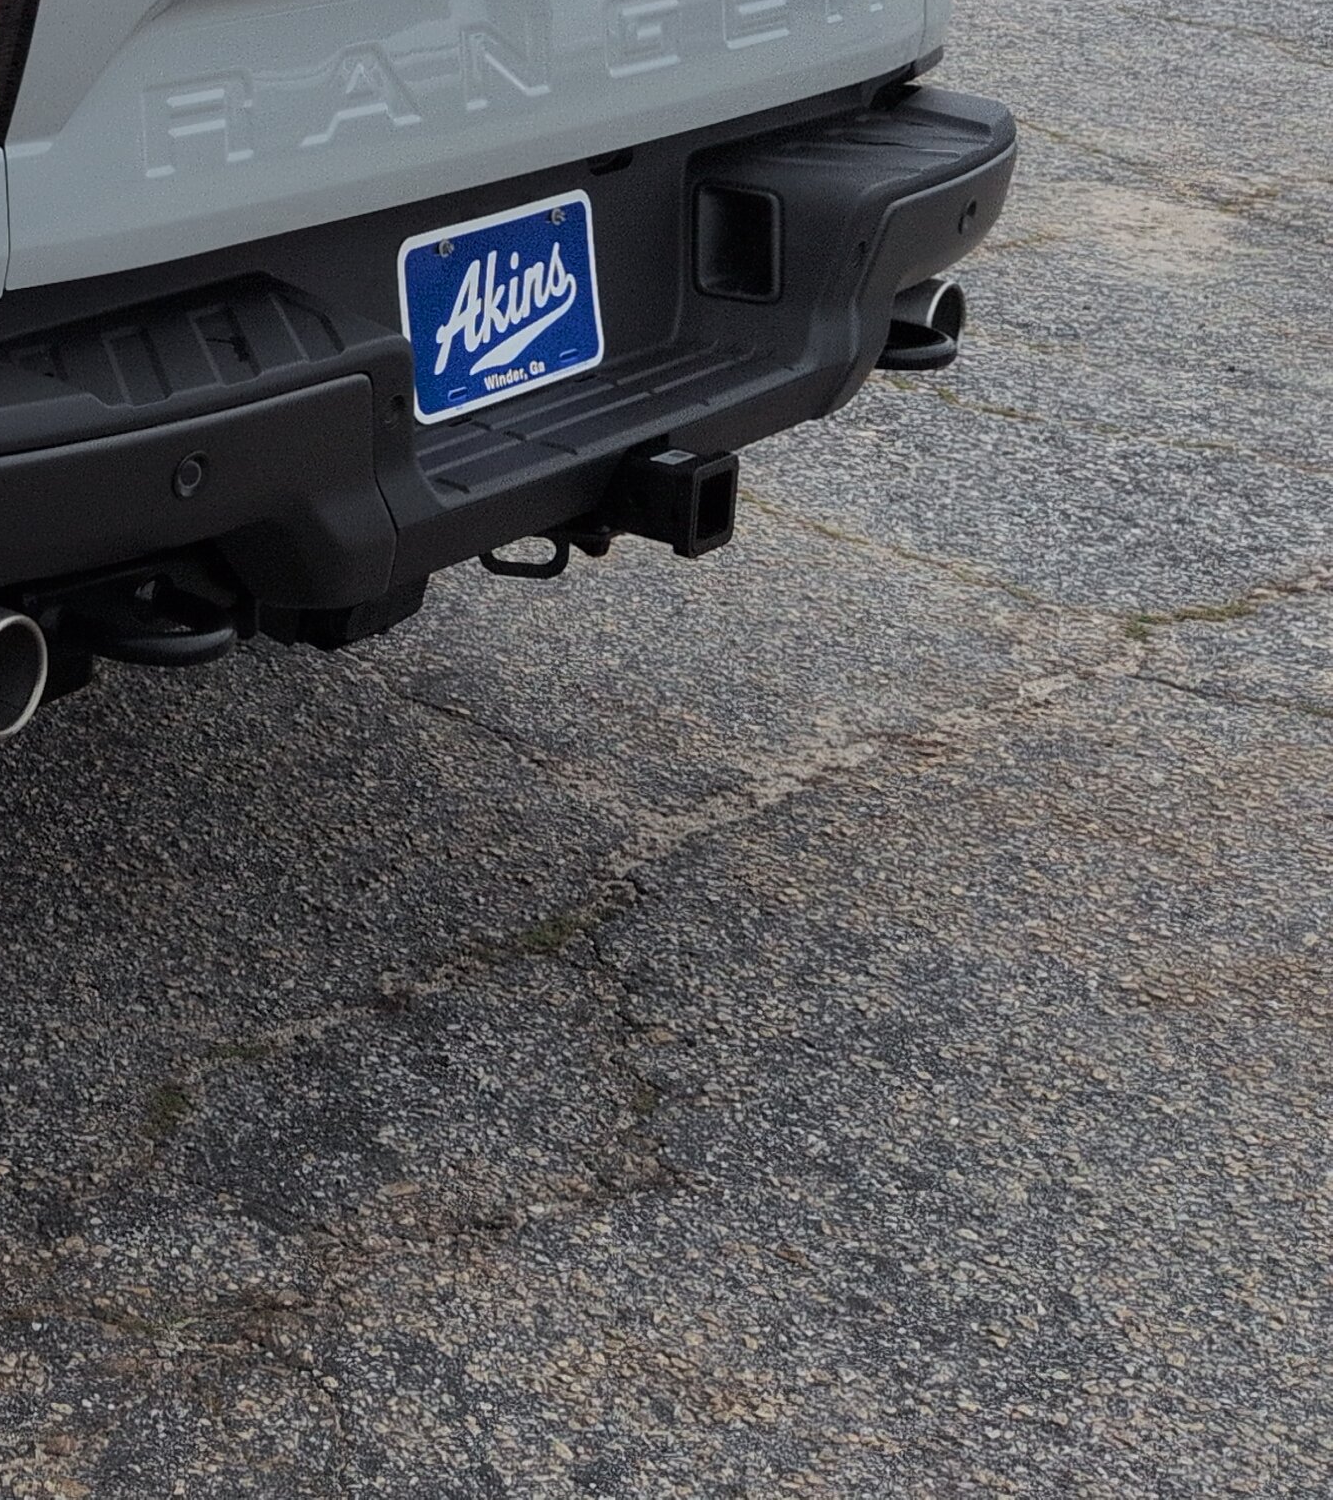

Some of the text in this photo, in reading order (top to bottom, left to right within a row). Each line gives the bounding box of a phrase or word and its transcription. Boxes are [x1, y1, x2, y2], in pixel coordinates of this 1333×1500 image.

[434, 242, 577, 375] Akins
[484, 360, 546, 391] Winder, Ga
